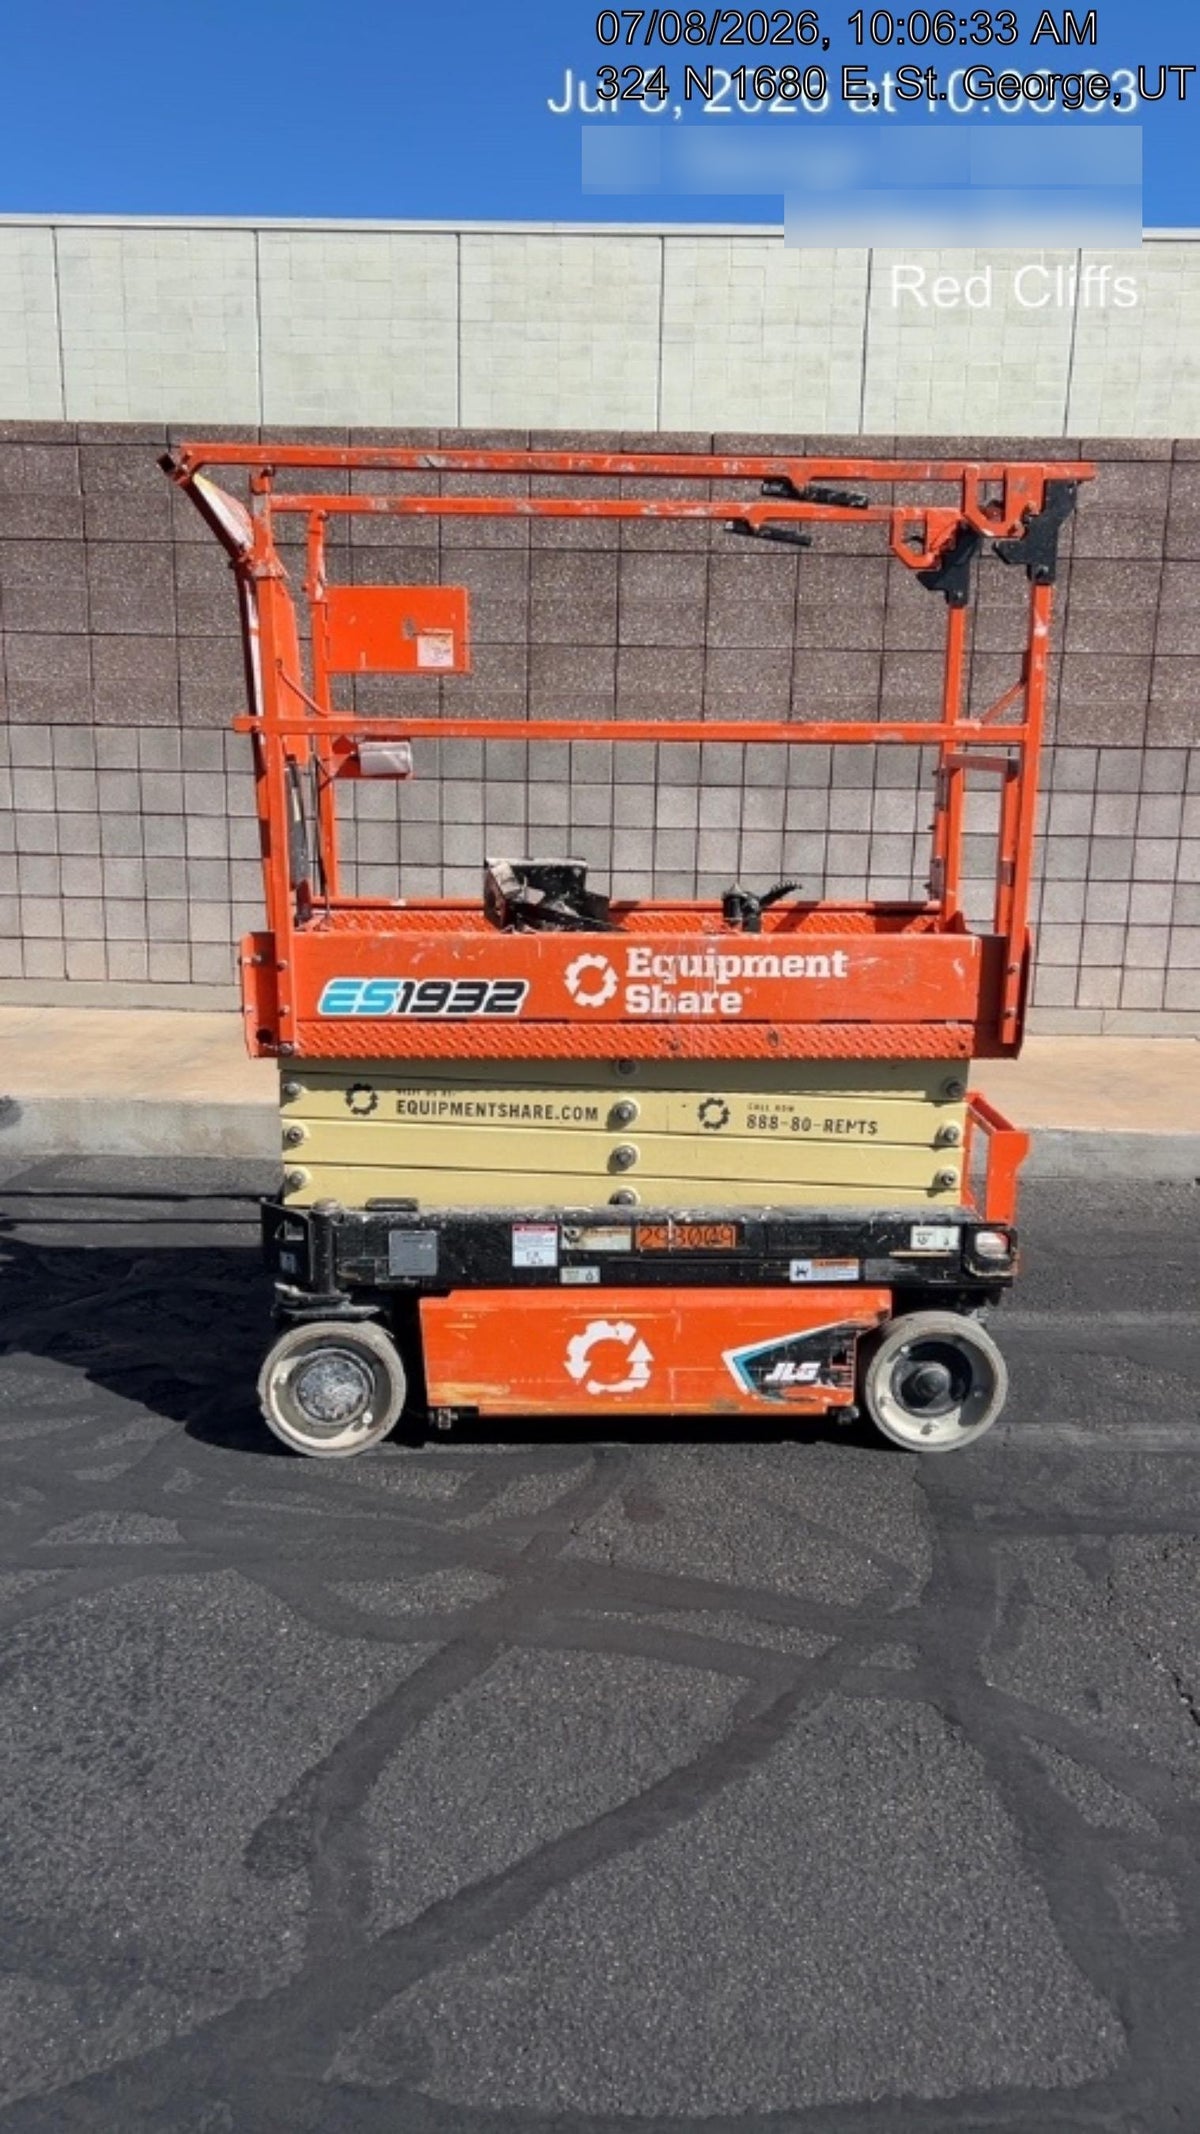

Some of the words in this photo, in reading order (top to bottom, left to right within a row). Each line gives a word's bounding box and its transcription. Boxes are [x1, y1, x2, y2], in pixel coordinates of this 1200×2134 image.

[625, 947, 849, 985] Equipment
[318, 978, 530, 1016] ES1932
[625, 984, 743, 1014] Share
[396, 1099, 598, 1121] EQUIPMENTSHARE.COM
[764, 1362, 821, 1381] JLG
